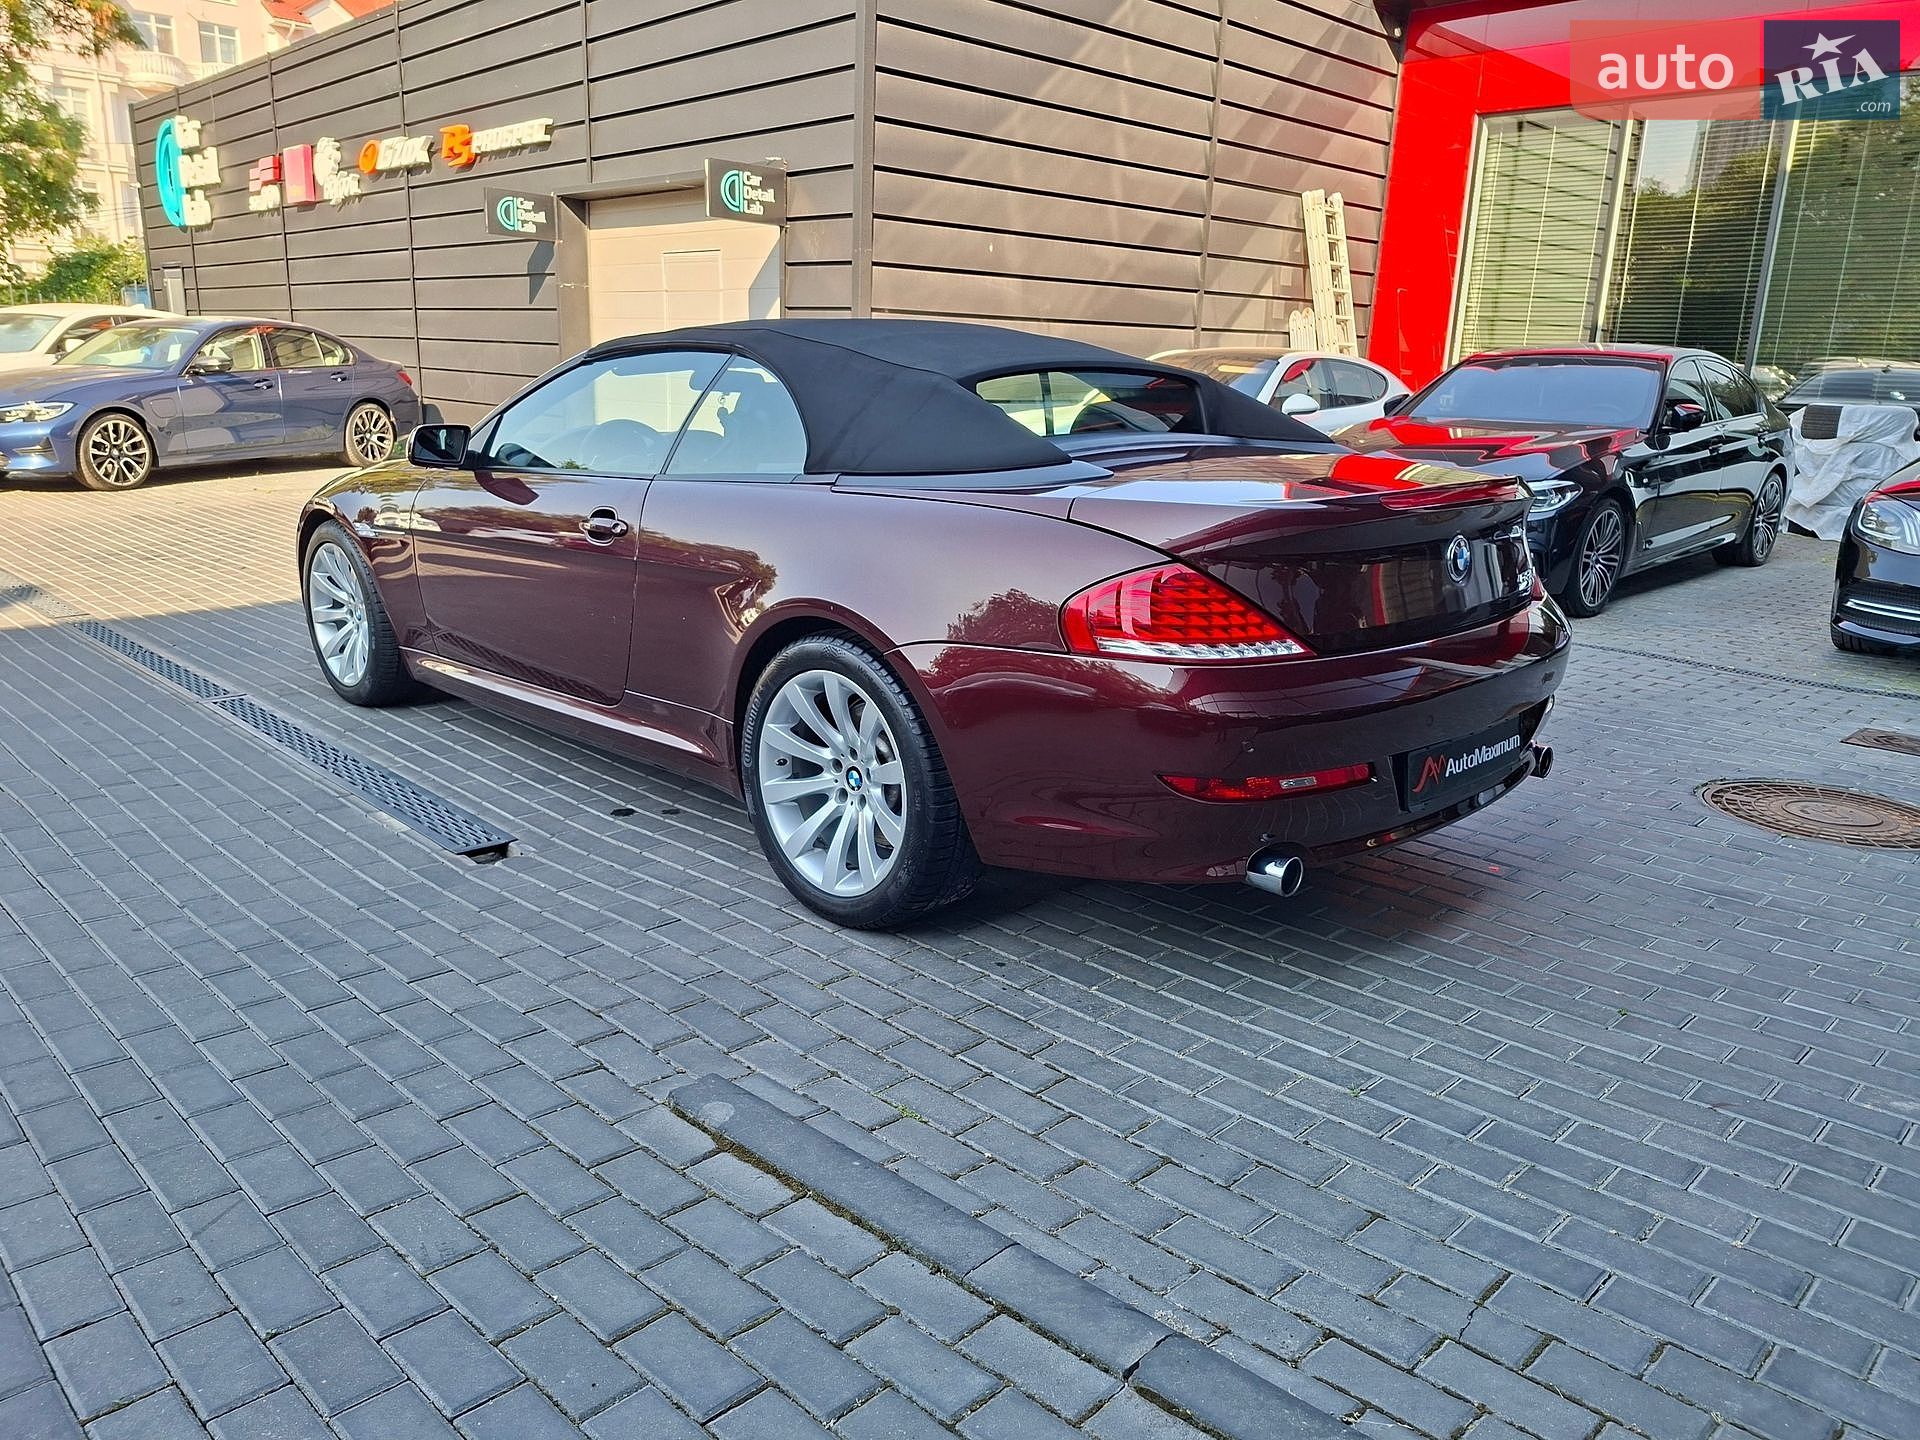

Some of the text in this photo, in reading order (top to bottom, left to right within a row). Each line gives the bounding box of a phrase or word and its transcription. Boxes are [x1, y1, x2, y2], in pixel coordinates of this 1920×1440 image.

[743, 171, 763, 187] Car
[743, 185, 776, 203] Detail
[743, 200, 764, 215] Lab
[1445, 734, 1521, 778] AutoMaximum
